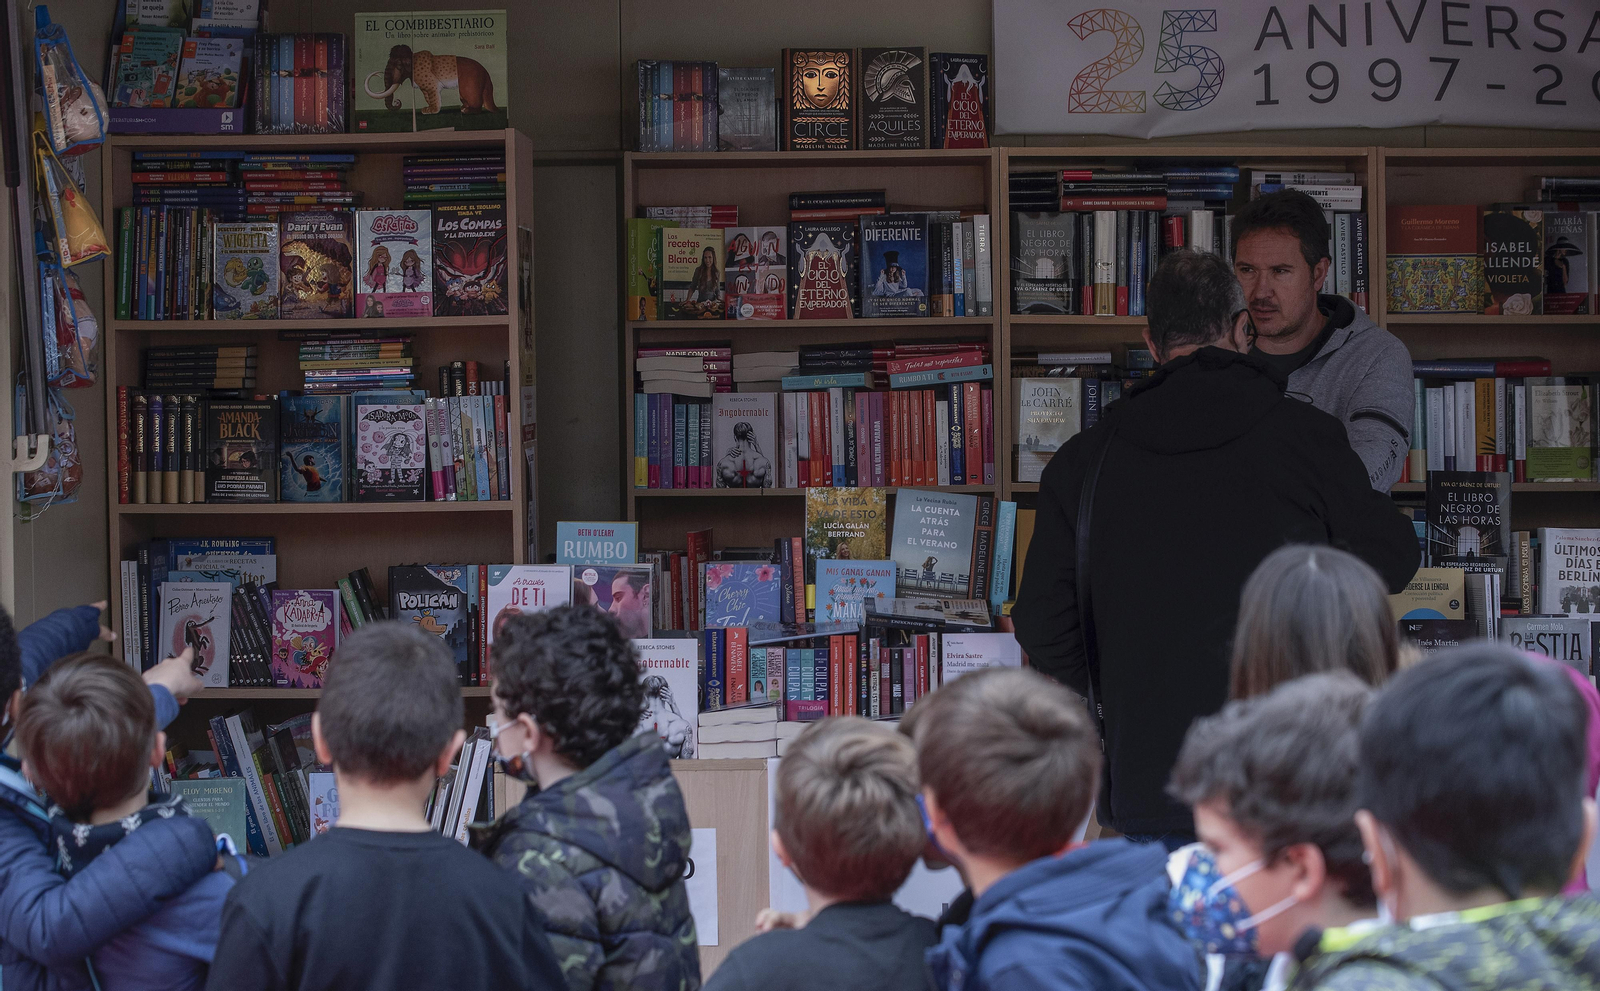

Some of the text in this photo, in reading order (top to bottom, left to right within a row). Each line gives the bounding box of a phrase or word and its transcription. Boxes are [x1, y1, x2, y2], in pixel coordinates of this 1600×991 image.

[366, 17, 494, 31] EL COMBIBESTIARIO
[1067, 8, 1225, 114] 25
[952, 101, 978, 113] CICLO
[958, 112, 972, 120] DEL
[794, 122, 848, 137] CIRCE
[868, 121, 921, 136] AQUILES
[947, 121, 984, 132] ETERNO
[947, 131, 985, 140] EMPERADOR
[287, 222, 343, 232] Dani y Evan
[438, 218, 502, 231] LOS COMPAS
[1547, 216, 1583, 233] MARÍA DUEÑAS
[865, 228, 921, 241] DIFERENTE
[1027, 230, 1065, 238] EL LIBRO
[223, 233, 267, 248] WIGETTA
[668, 240, 700, 248] recetas
[1020, 239, 1070, 248] NEGRO DE
[1020, 249, 1072, 257] LAS HORAS
[1486, 242, 1532, 253] ISABEL
[668, 255, 698, 264] Blanca
[818, 262, 828, 270] EL
[807, 270, 840, 283] CICLO
[1488, 274, 1530, 284] VIOLETA
[800, 289, 847, 300] ETERNO
[800, 300, 847, 310] EMPERADOR
[1031, 388, 1061, 397] JOHN
[1087, 385, 1096, 410] JOHN
[1033, 397, 1072, 408] CARRÉ
[217, 412, 262, 423] AMANDA
[367, 410, 419, 420] ISADORA MOON
[718, 408, 769, 418] Ingobernable
[220, 423, 262, 440] BLACK
[689, 419, 698, 440] CULPA
[701, 418, 710, 457] CULPA MÍA
[826, 497, 868, 506] LA VIDA
[1448, 492, 1493, 502] EL LIBRO
[816, 509, 877, 519] VA DE ESTO
[924, 506, 960, 517] CUENTA
[981, 501, 989, 525] CIRCE
[1440, 504, 1500, 514] NEGRO DE
[824, 521, 869, 529] LUCÍA GALÁN
[920, 516, 949, 526] ATRÁS
[1440, 515, 1501, 525] LAS HORAS
[593, 529, 614, 537] O'LEARY
[922, 528, 945, 537] PARA
[564, 541, 627, 558] RUMBO
[920, 539, 958, 549] VERANO
[977, 531, 987, 571] MADELINE
[1566, 556, 1592, 569] DÍAS
[826, 567, 891, 577] MIS GANAS GANAN
[1559, 570, 1600, 582] BERLÍN
[511, 588, 546, 605] DE TI
[718, 587, 749, 602] Cherry
[399, 591, 458, 610] POLICÁN
[725, 599, 746, 613] Chic
[168, 600, 189, 615] Perro
[283, 602, 325, 623] KADABRA
[1527, 622, 1564, 631] Carmen Mola
[861, 643, 866, 651] UN
[1510, 631, 1583, 660] BESTIA
[788, 666, 801, 692] CULPA
[801, 666, 813, 692] CULPA
[815, 666, 828, 692] CULPA
[261, 812, 269, 824] libro
[265, 824, 273, 836] gran
